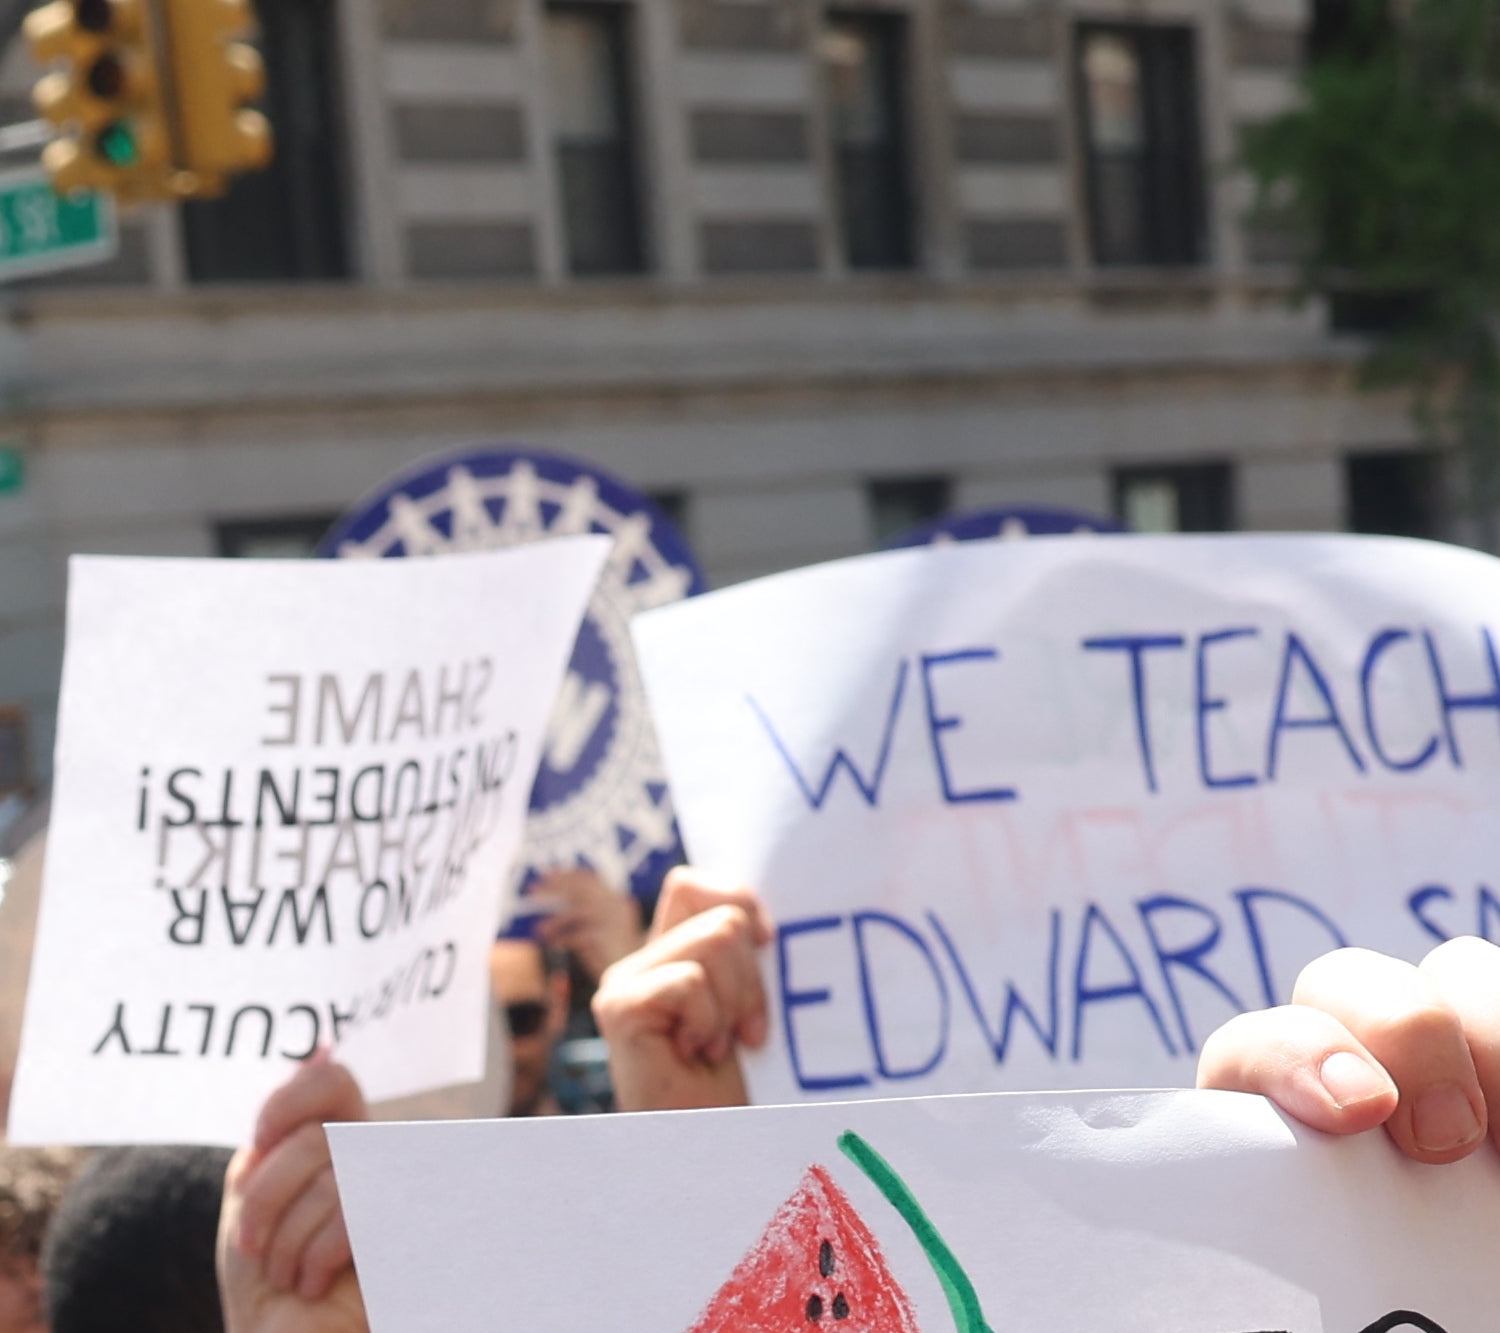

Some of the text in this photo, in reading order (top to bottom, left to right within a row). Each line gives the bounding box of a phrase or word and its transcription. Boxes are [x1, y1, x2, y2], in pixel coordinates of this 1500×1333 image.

[136, 747, 469, 833] STUDENTS!
[747, 645, 1015, 810] WE
[165, 886, 335, 949] WAR
[775, 886, 1357, 1091] EDWARD
